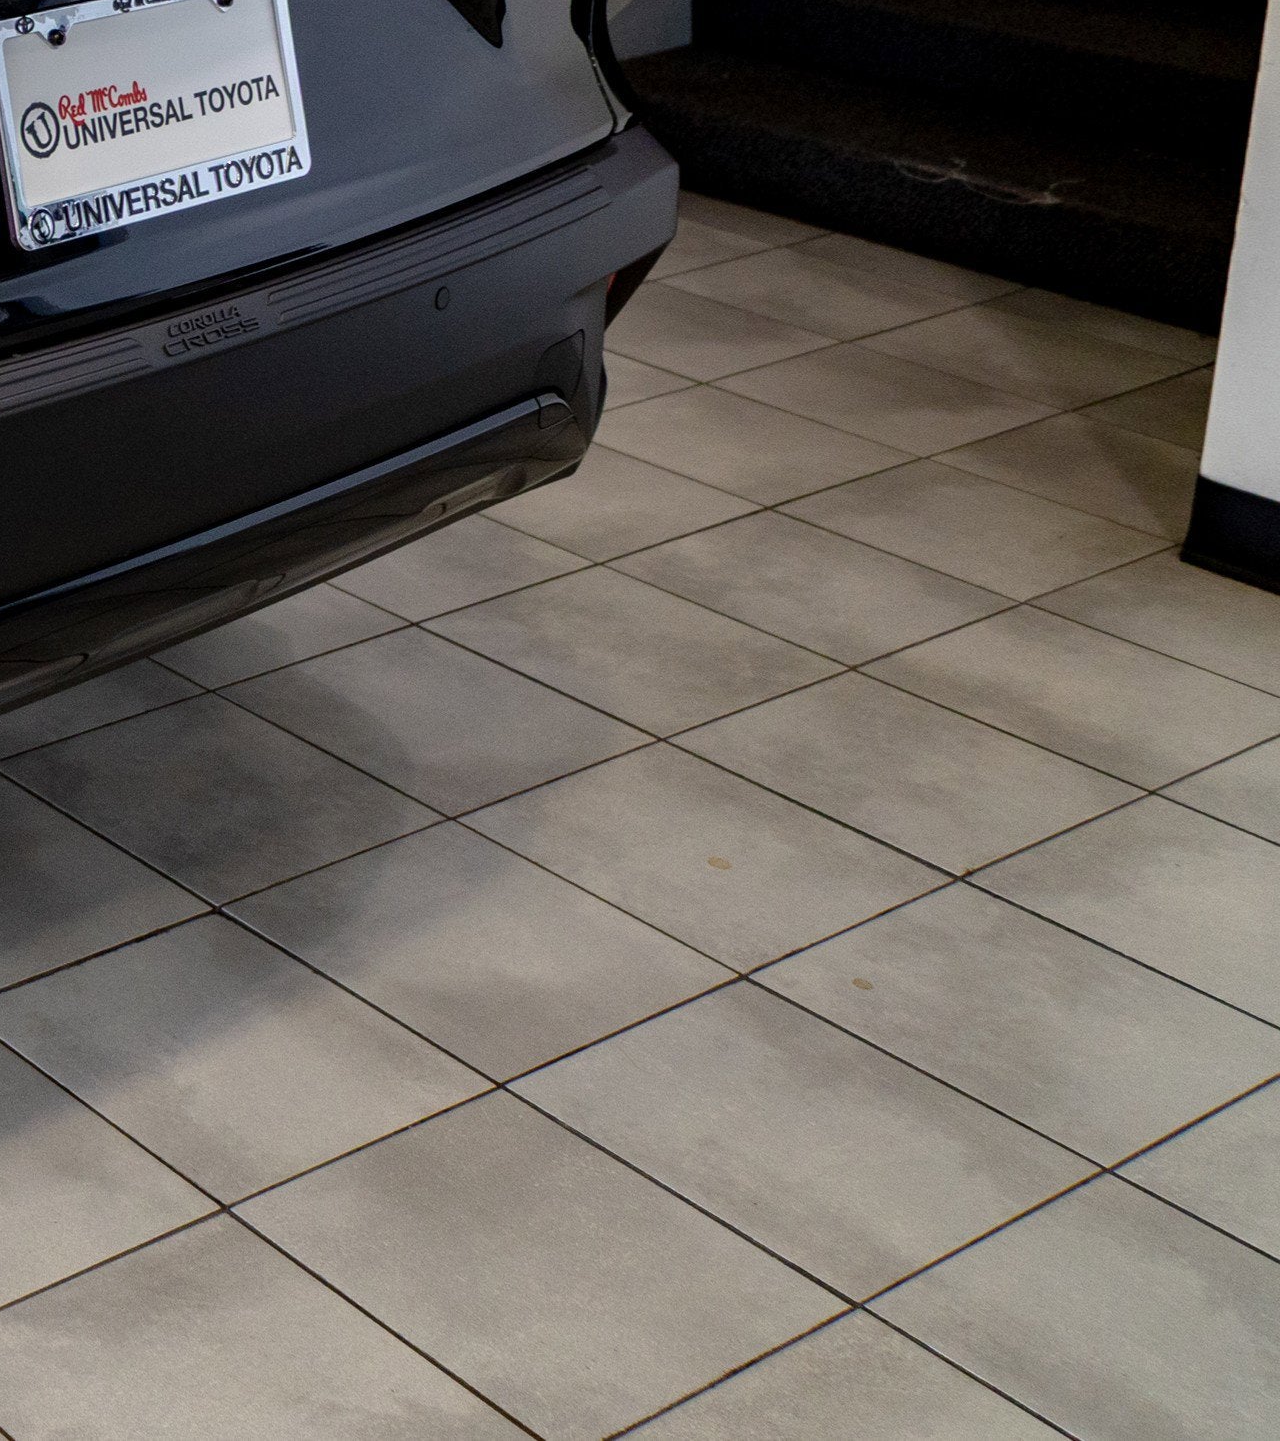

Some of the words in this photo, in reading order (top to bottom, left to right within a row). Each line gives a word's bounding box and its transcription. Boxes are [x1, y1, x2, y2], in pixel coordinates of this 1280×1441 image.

[58, 95, 86, 126] Red
[85, 80, 147, 113] McCombs
[62, 100, 193, 150] UNIVERSAL
[193, 74, 280, 117] TOYOTA
[62, 171, 210, 232] UNIVERSAL
[208, 146, 304, 193] TOYOTA
[163, 318, 260, 357] CROSS
[167, 306, 241, 338] COROLLA
